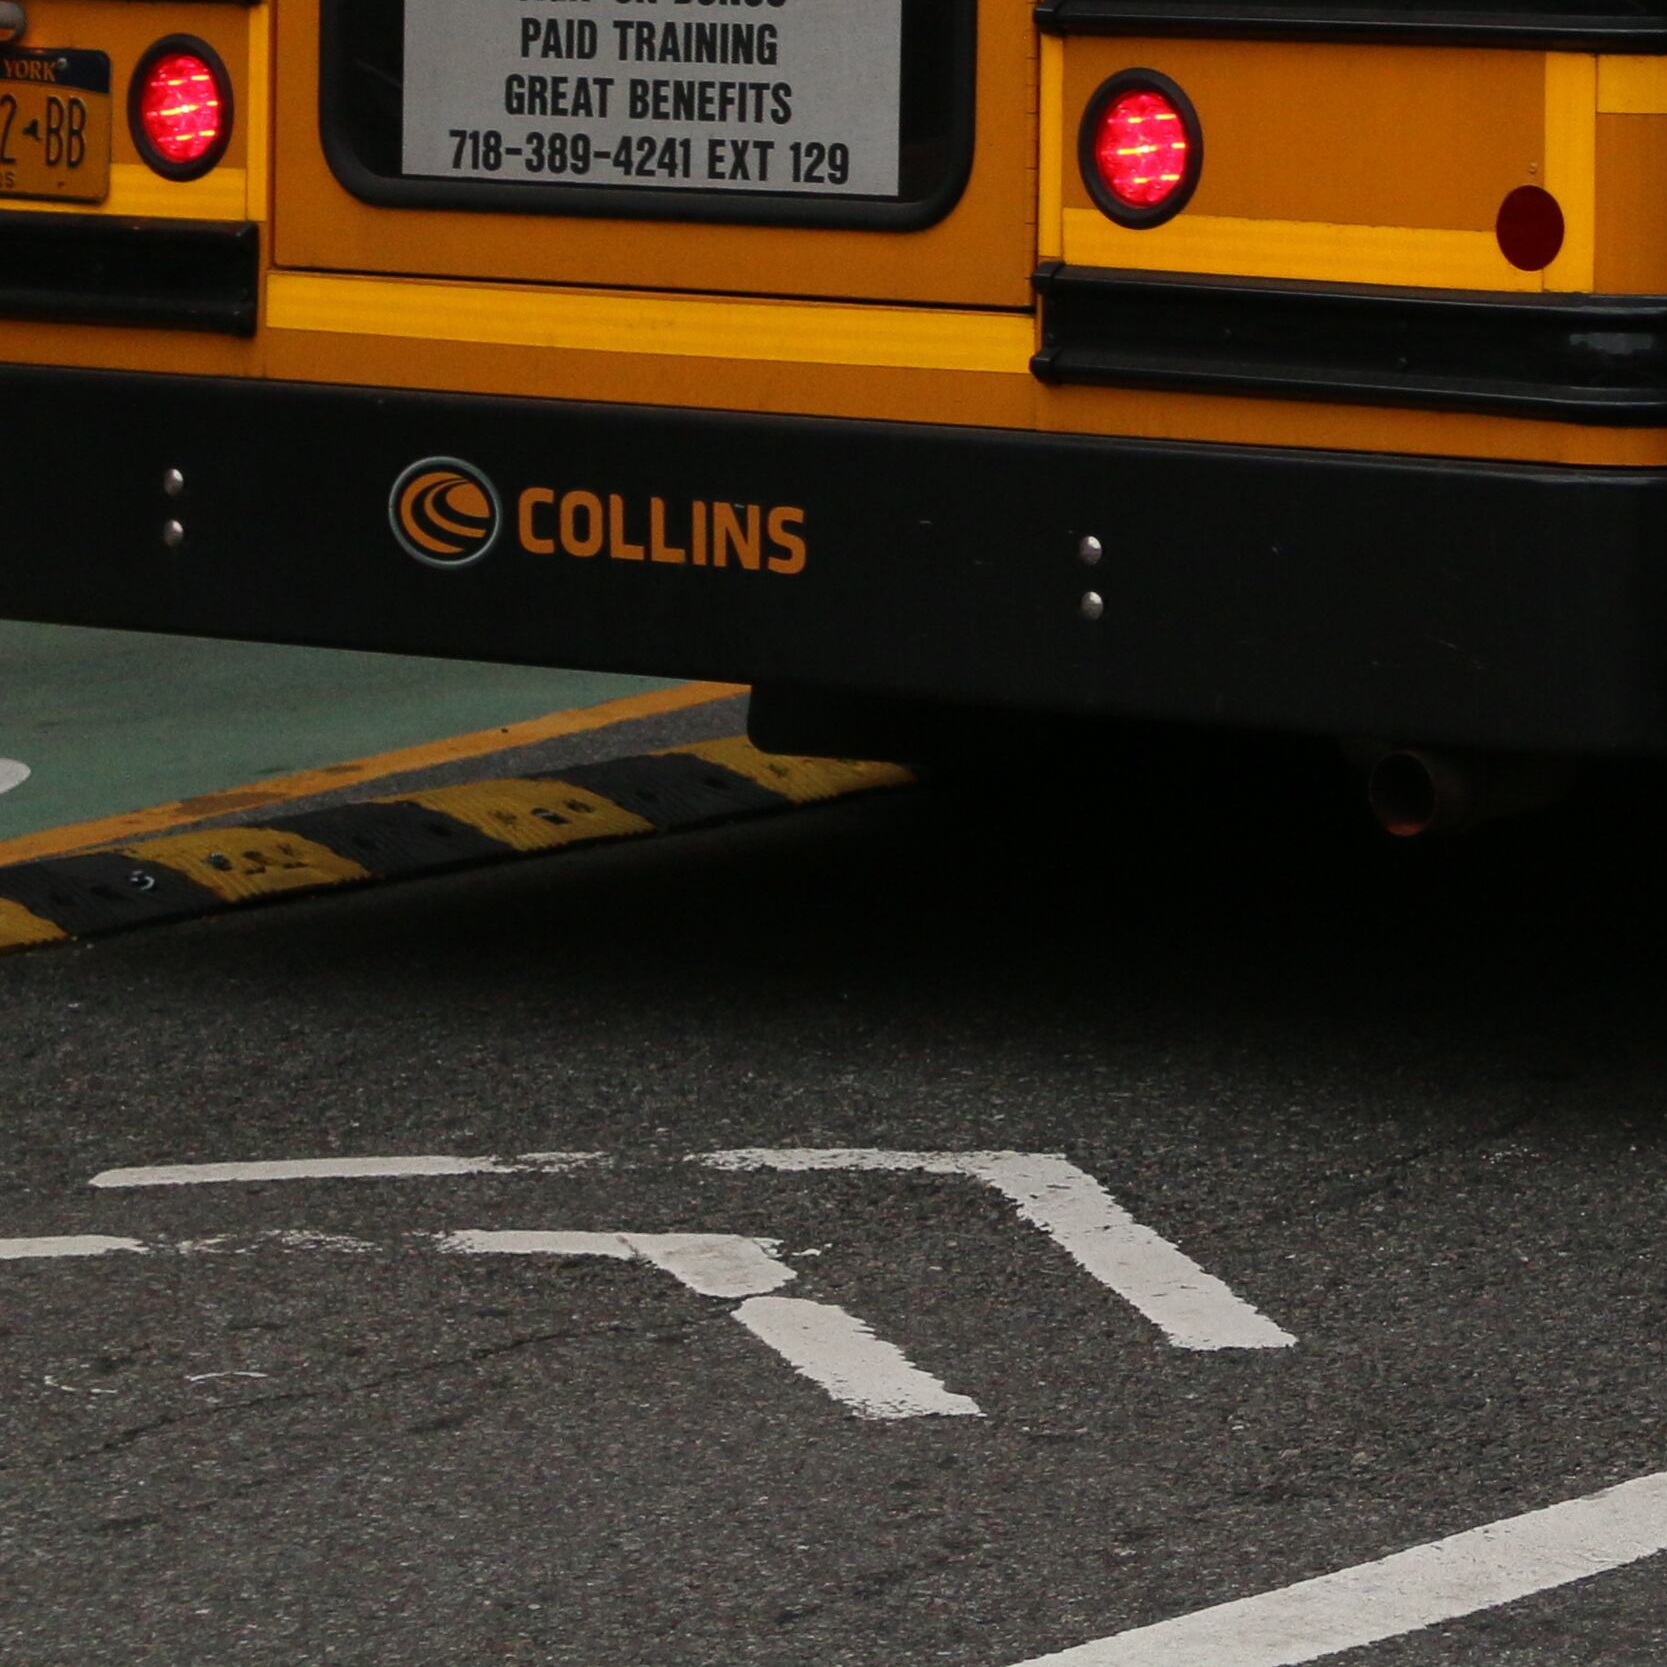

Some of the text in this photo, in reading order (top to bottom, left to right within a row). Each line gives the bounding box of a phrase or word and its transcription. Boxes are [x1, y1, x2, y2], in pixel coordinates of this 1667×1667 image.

[520, 18, 778, 65] PAID TRAINING
[4, 59, 57, 82] YORK
[505, 73, 792, 125] GREAT BENEFITS
[449, 129, 849, 185] 718-389-4241 EXT 129
[518, 487, 807, 574] COLLINS
